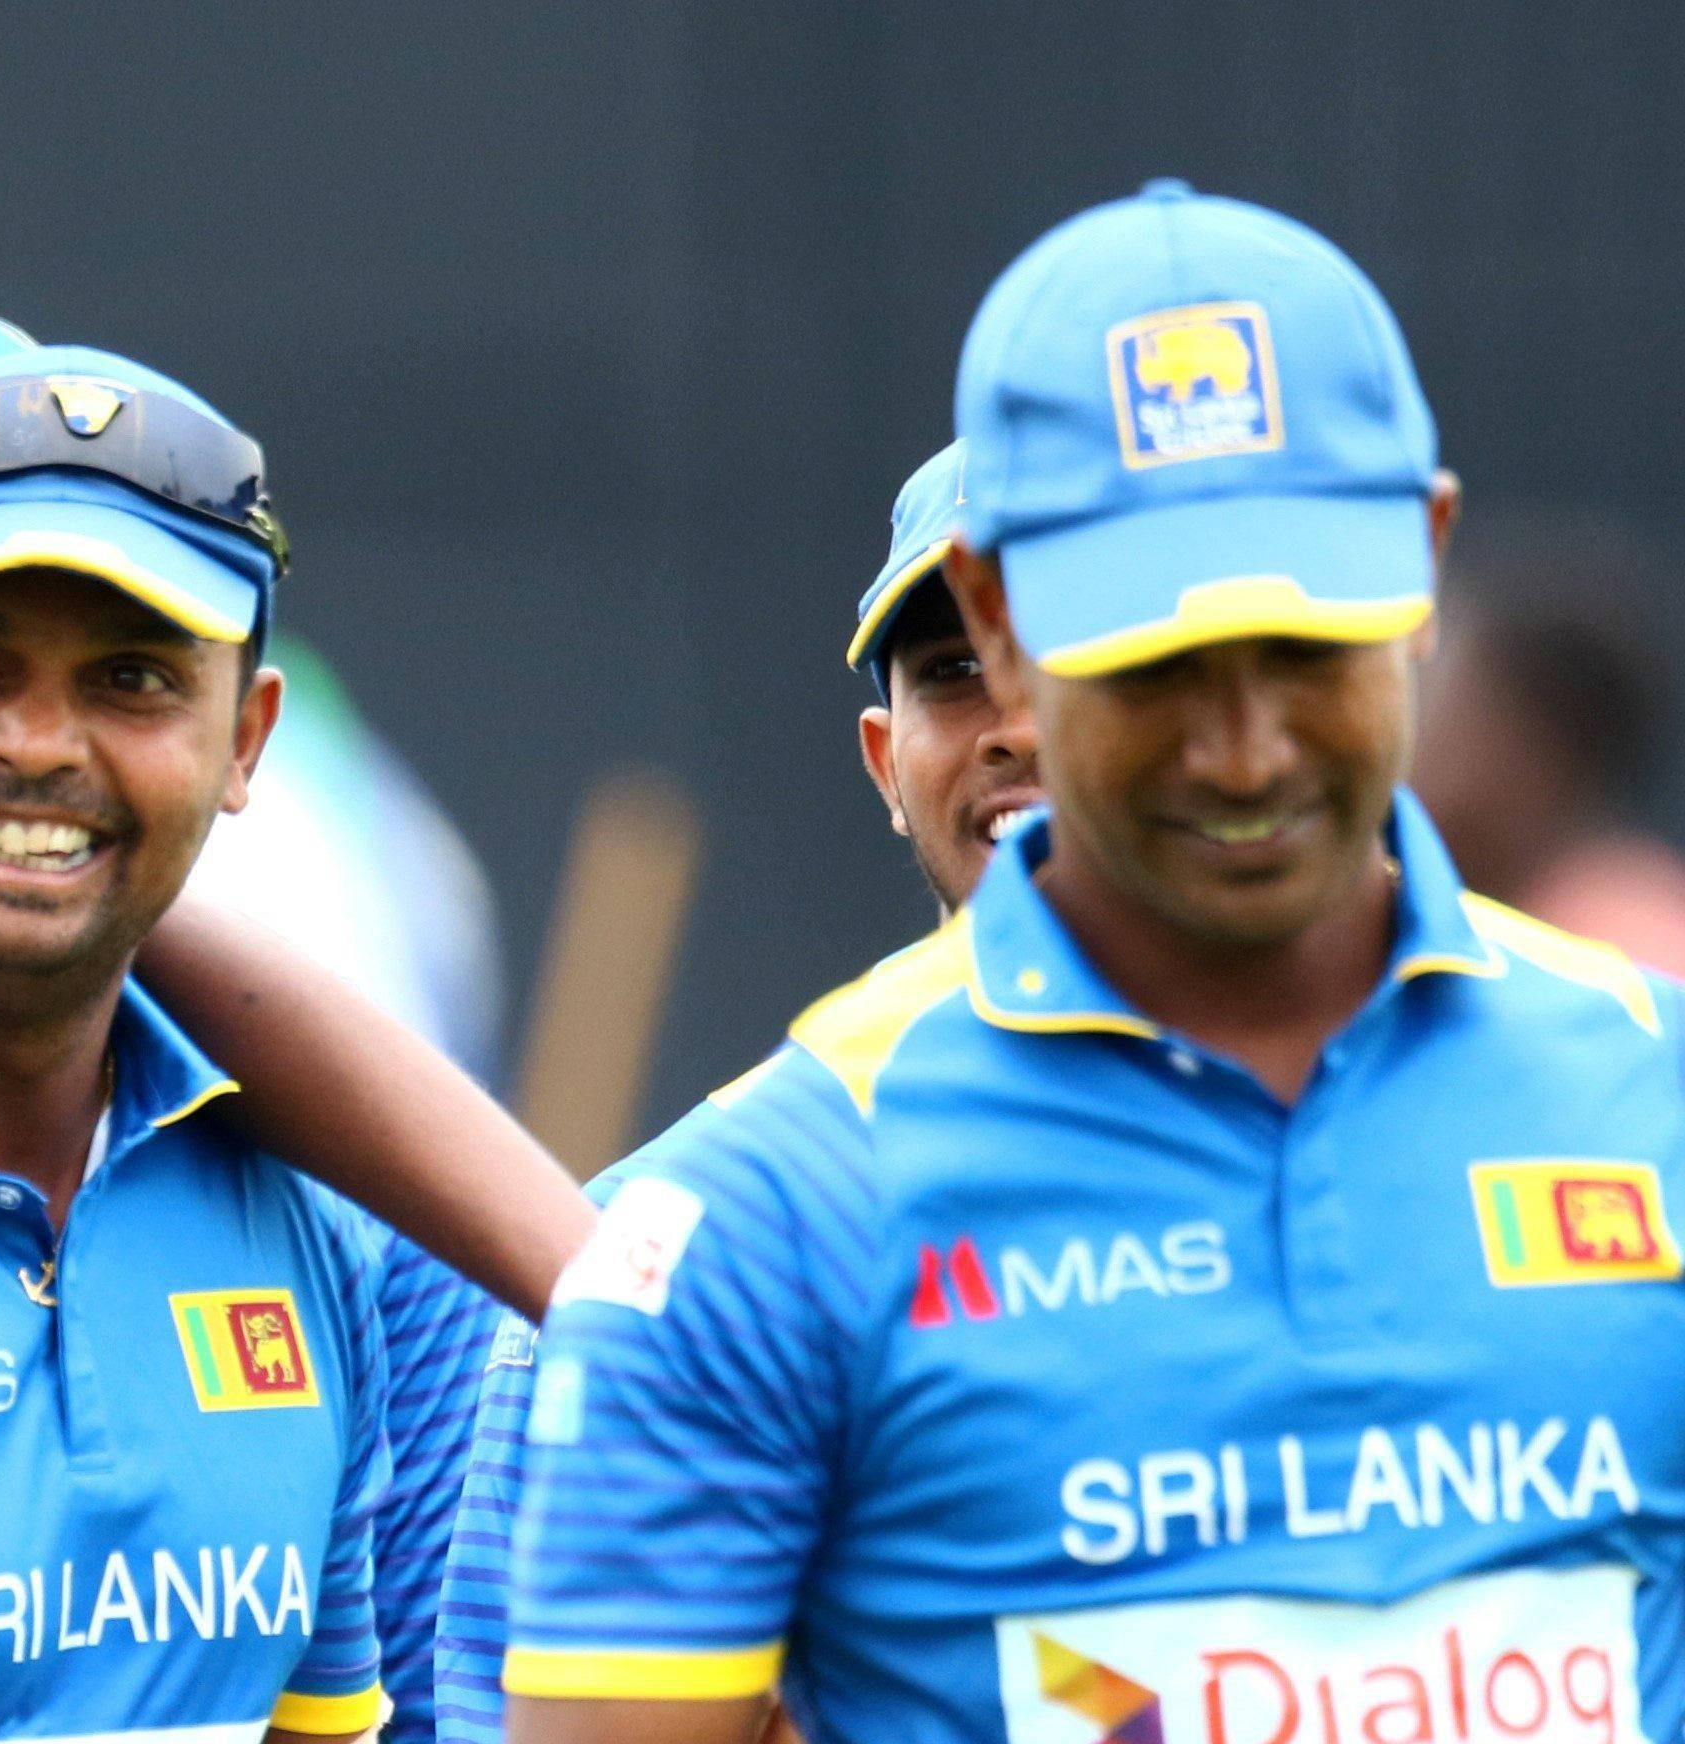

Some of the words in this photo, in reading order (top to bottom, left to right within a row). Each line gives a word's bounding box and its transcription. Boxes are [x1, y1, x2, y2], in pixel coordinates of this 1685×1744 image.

[1001, 1223, 1231, 1316] MAS
[1060, 1444, 1248, 1566] SRI
[1279, 1415, 1640, 1539] LANKA
[58, 1543, 313, 1652] LANKA
